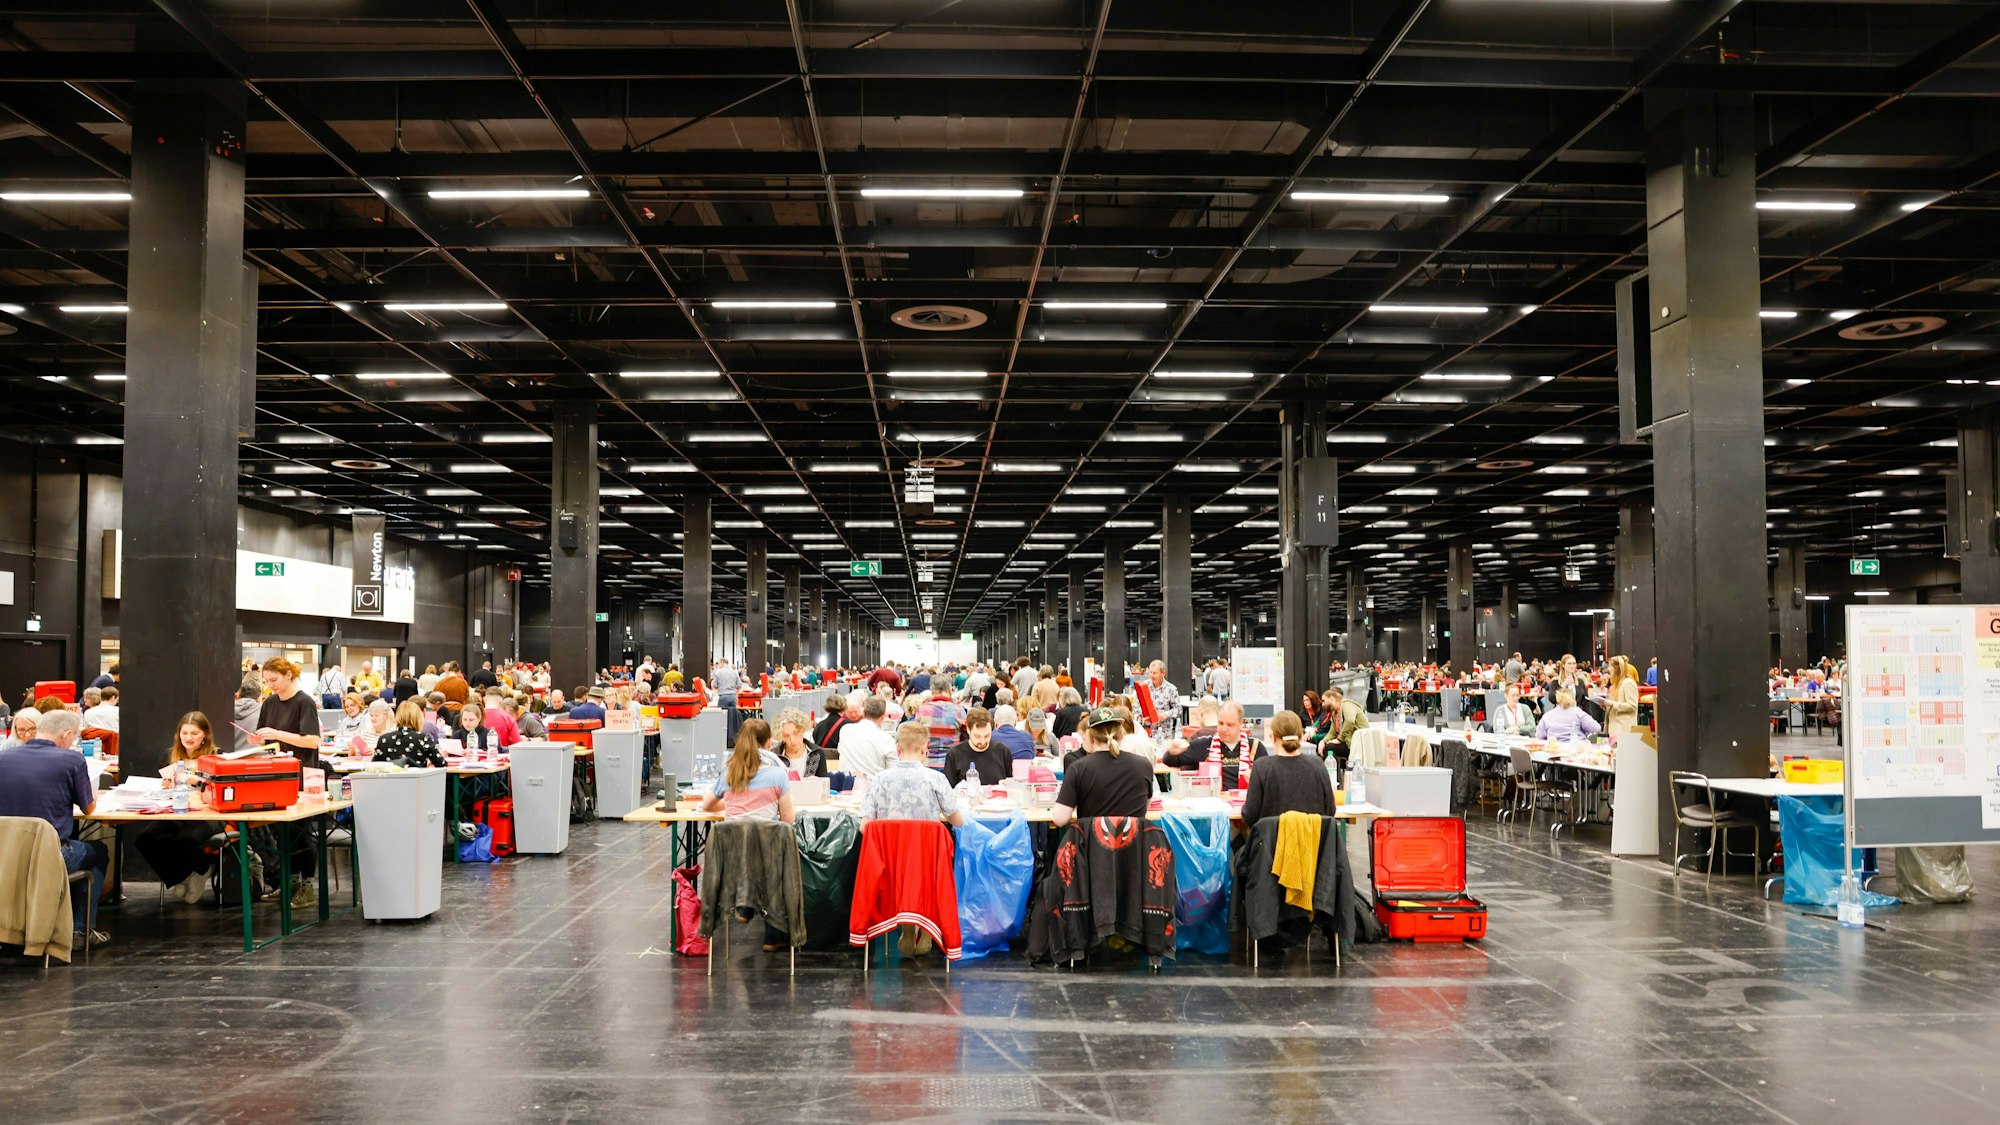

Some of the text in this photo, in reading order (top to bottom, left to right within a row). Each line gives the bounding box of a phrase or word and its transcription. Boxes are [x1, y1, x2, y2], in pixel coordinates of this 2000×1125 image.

[1318, 495, 1325, 506] F
[1317, 511, 1326, 523] 11
[370, 532, 382, 581] Newton
[1885, 738, 1891, 746] B
